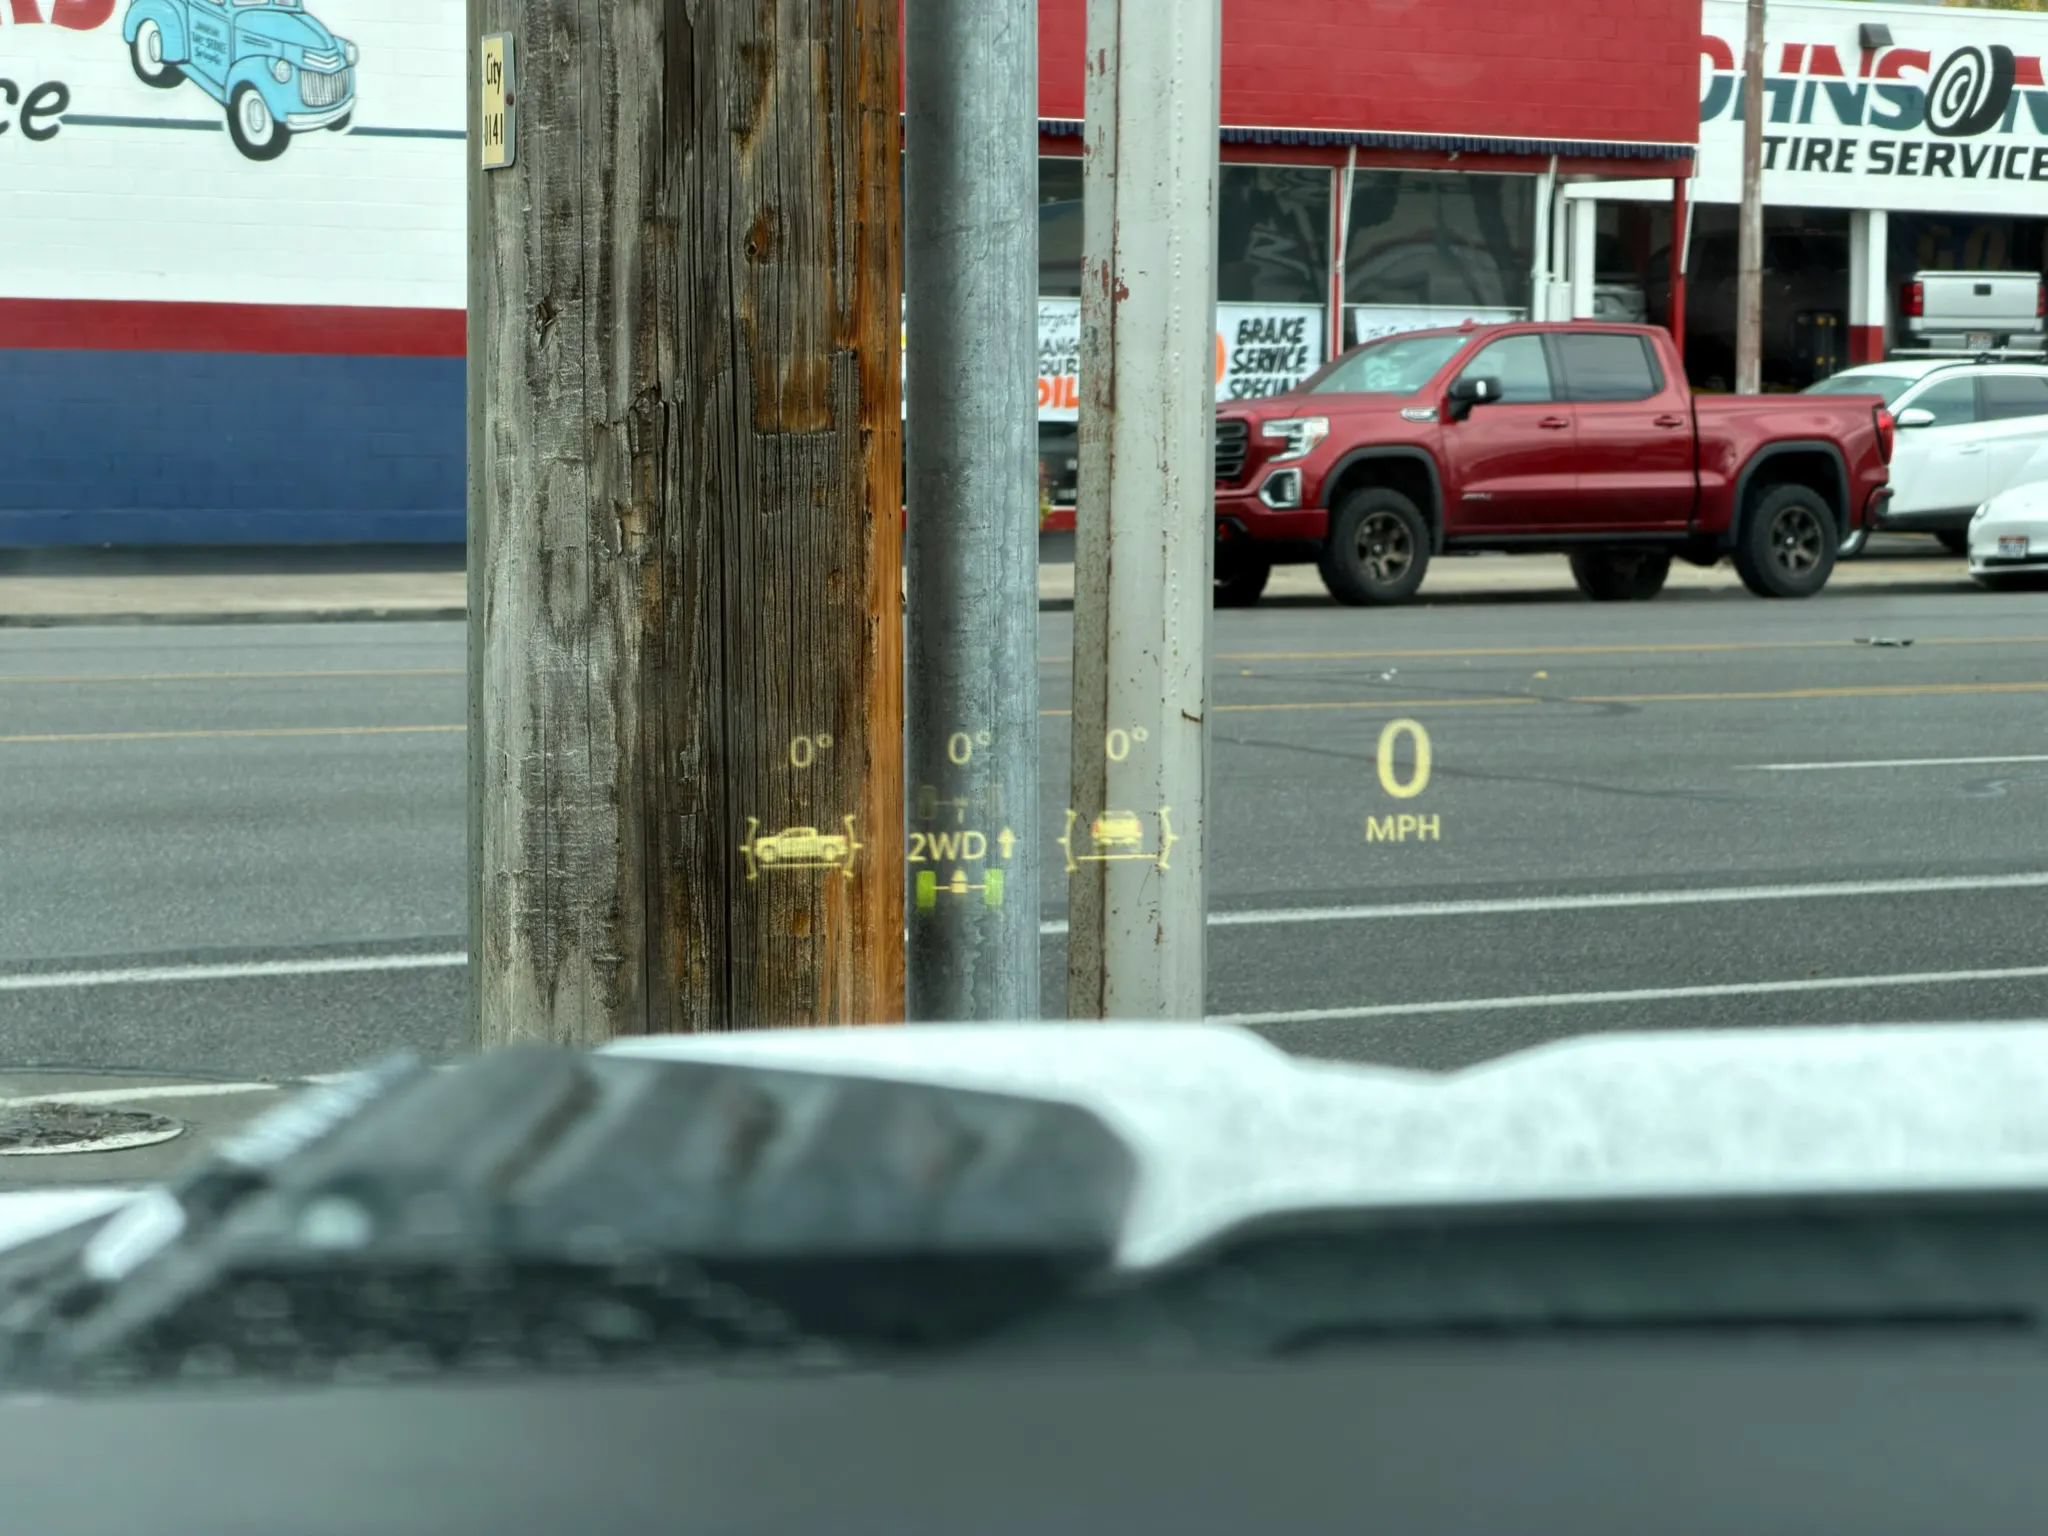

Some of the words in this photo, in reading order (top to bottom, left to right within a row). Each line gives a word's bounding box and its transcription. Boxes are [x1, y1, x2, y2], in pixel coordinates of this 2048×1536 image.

[486, 53, 502, 95] City
[1761, 135, 1858, 173] TIRE
[1866, 140, 2048, 181] SERVICE
[1237, 316, 1307, 345] BRAKE
[1230, 345, 1309, 375] SERVICE
[1377, 718, 1431, 799] 0
[1366, 812, 1440, 842] MPH
[907, 829, 987, 862] 2WD
